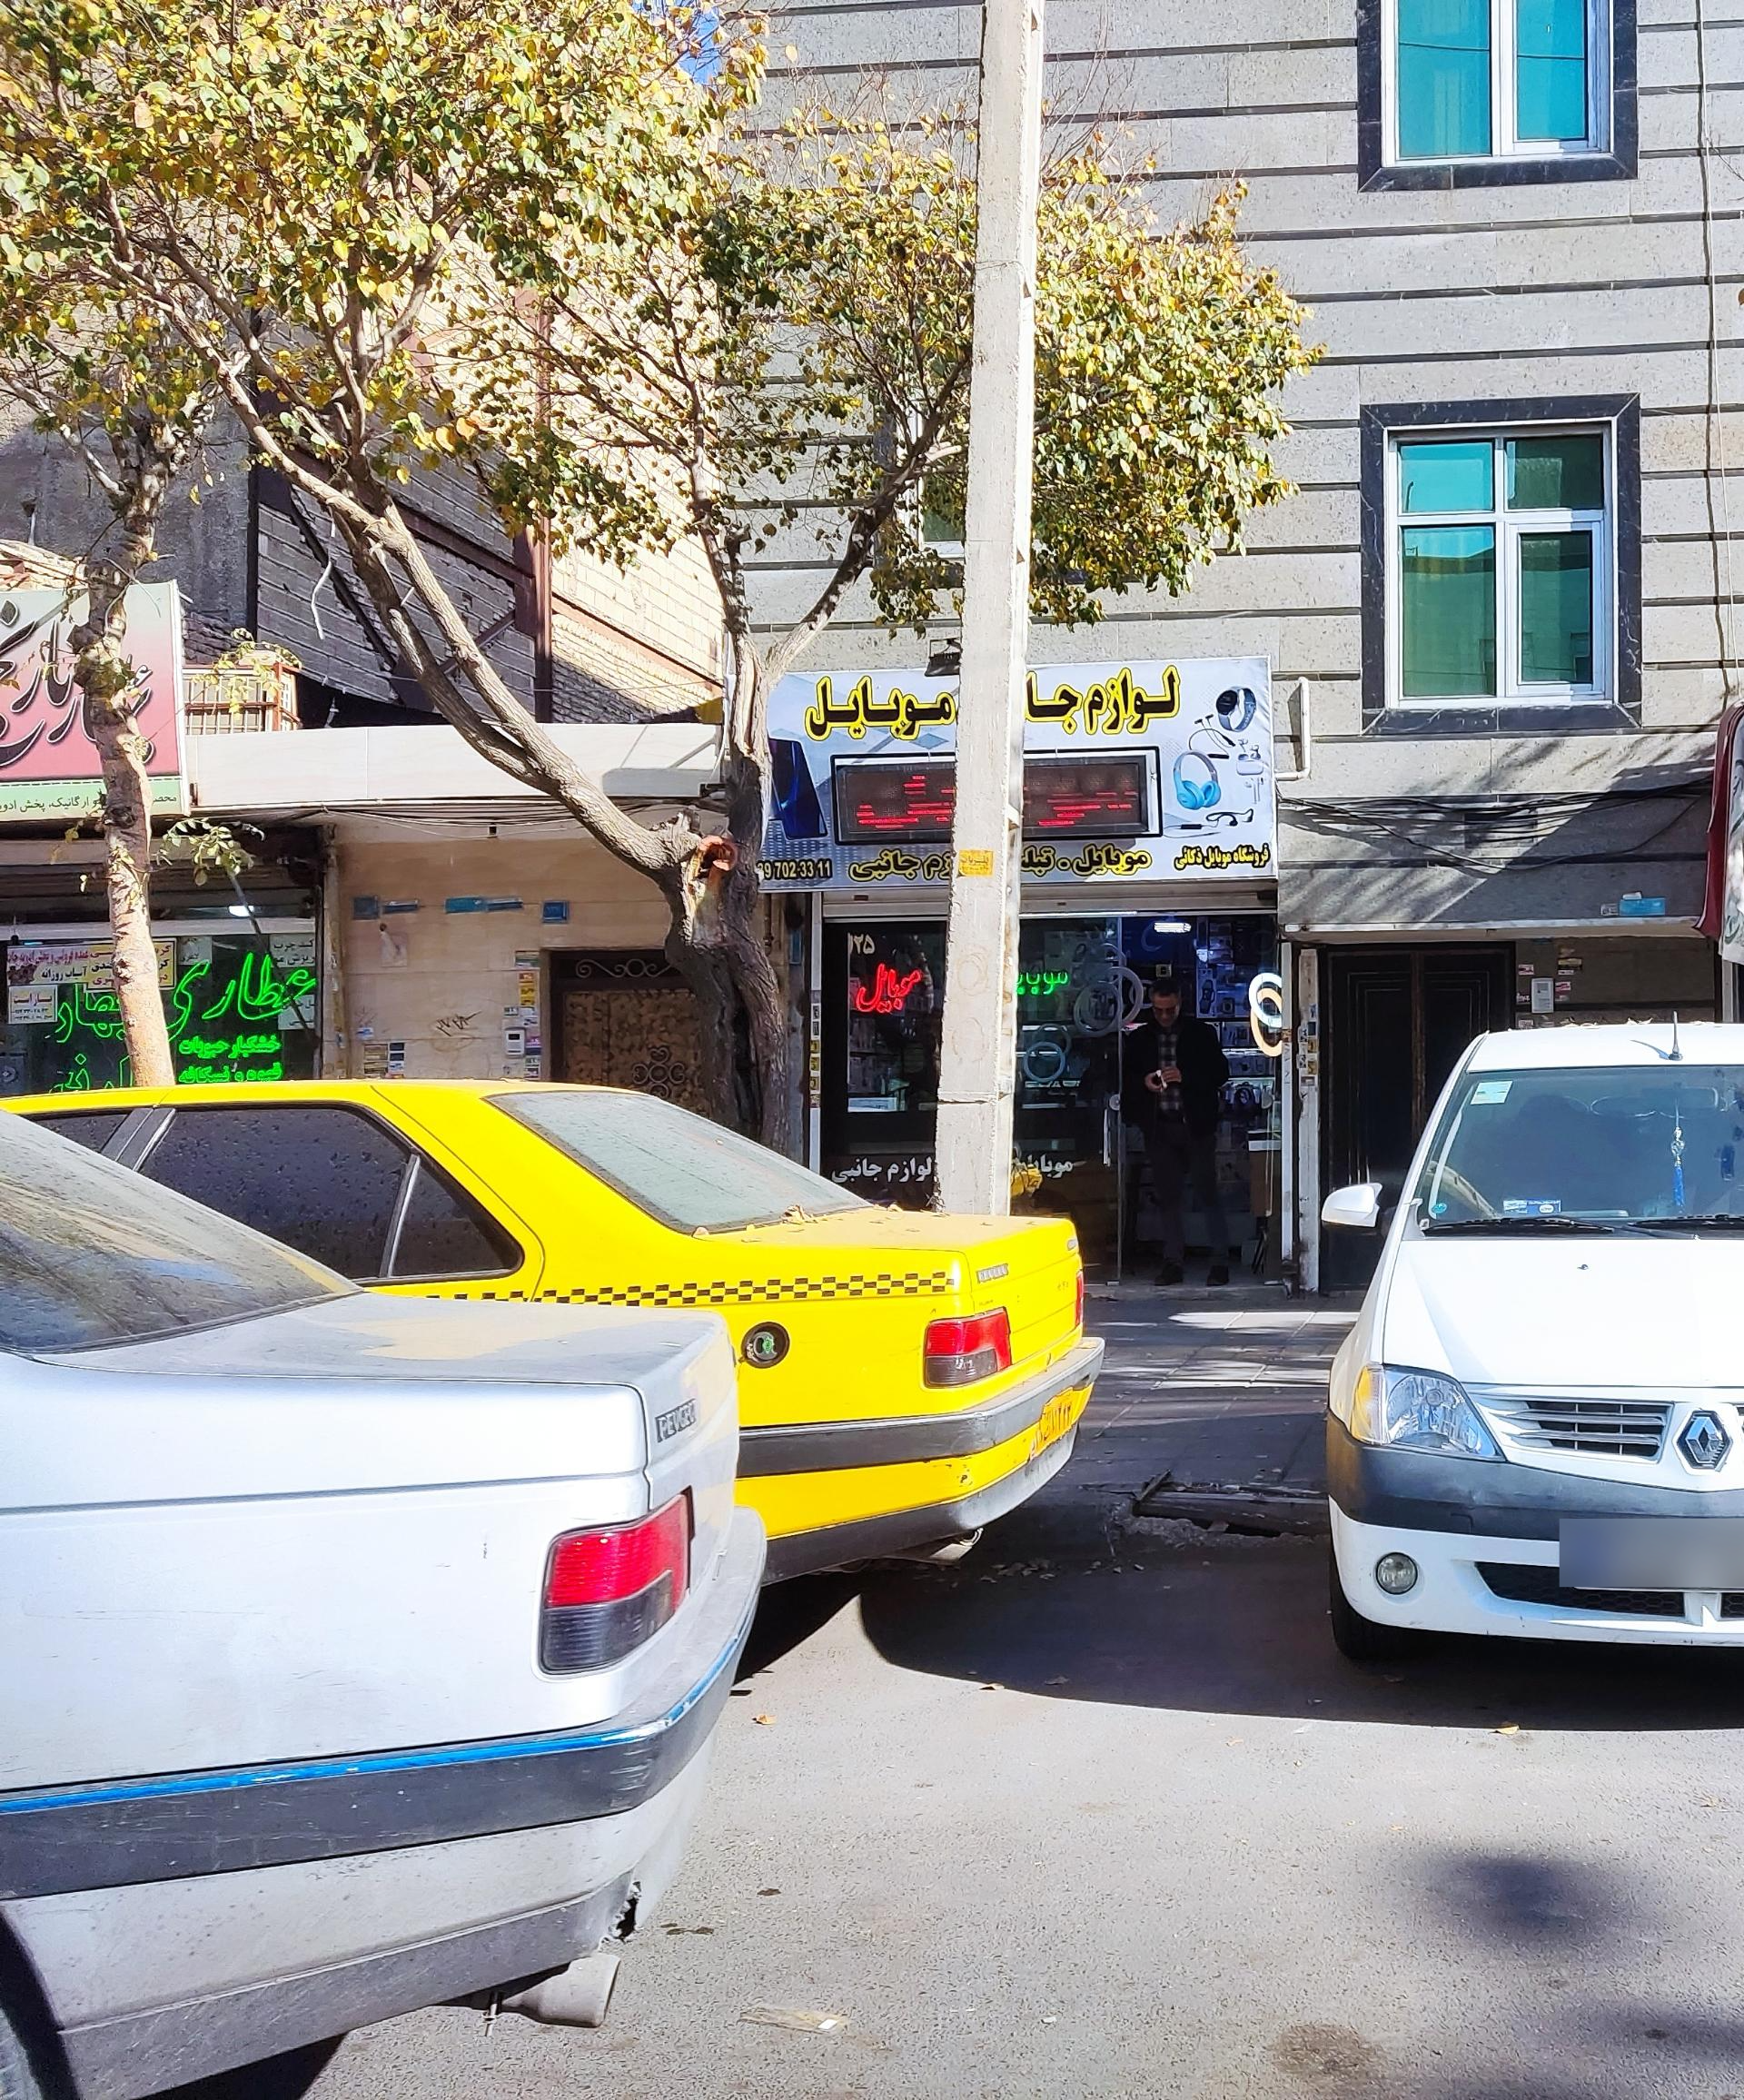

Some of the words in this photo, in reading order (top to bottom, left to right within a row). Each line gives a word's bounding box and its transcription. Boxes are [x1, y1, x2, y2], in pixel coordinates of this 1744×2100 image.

[805, 676, 956, 741] موبایل
[1084, 666, 1180, 735] لوازم
[20, 799, 45, 812] پخش
[848, 849, 922, 881] جانبی
[1021, 844, 1055, 876] تبل
[1072, 844, 1153, 876] موبایل
[1204, 846, 1233, 869] موبایل
[1233, 843, 1271, 868] فروشگاه
[165, 952, 316, 1042] عطاری
[831, 1157, 882, 1184] جانبی
[887, 1156, 932, 1182] لوازم
